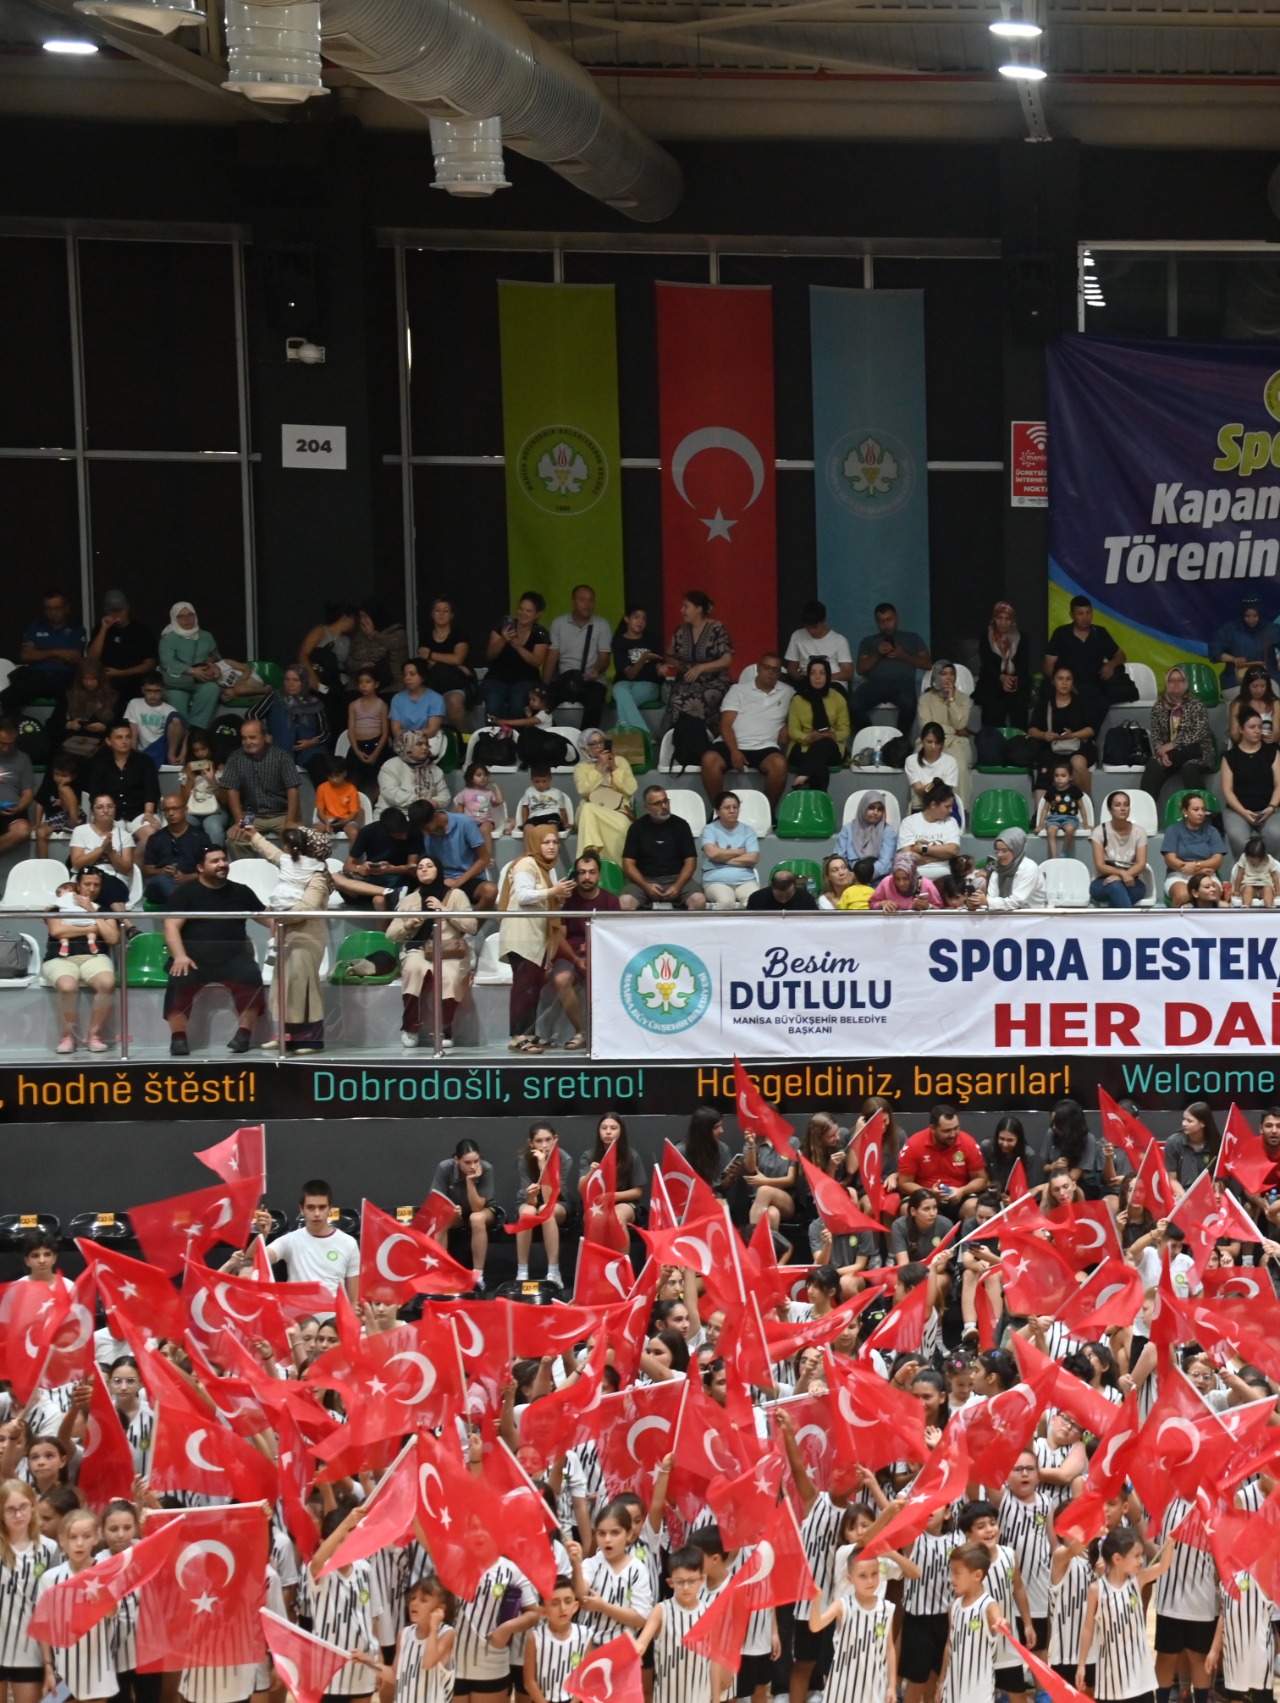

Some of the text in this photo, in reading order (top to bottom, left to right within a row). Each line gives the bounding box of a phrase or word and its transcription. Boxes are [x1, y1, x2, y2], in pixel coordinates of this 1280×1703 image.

[296, 438, 332, 453] 204
[762, 947, 859, 978] Besim
[928, 938, 1089, 982] SPORA
[730, 980, 892, 1010] DUTLULU
[733, 1014, 888, 1026] MANİSA BÜYÜKŞEHİR BELEDİYE
[788, 1026, 832, 1035] BAŞKANI
[994, 1002, 1141, 1047] HER
[18, 1071, 256, 1105] hodně štěstí!
[313, 1068, 645, 1103] Dobrodošli, sretno!
[914, 1065, 1071, 1103] başarılar!
[1122, 1063, 1275, 1093] Welcome
